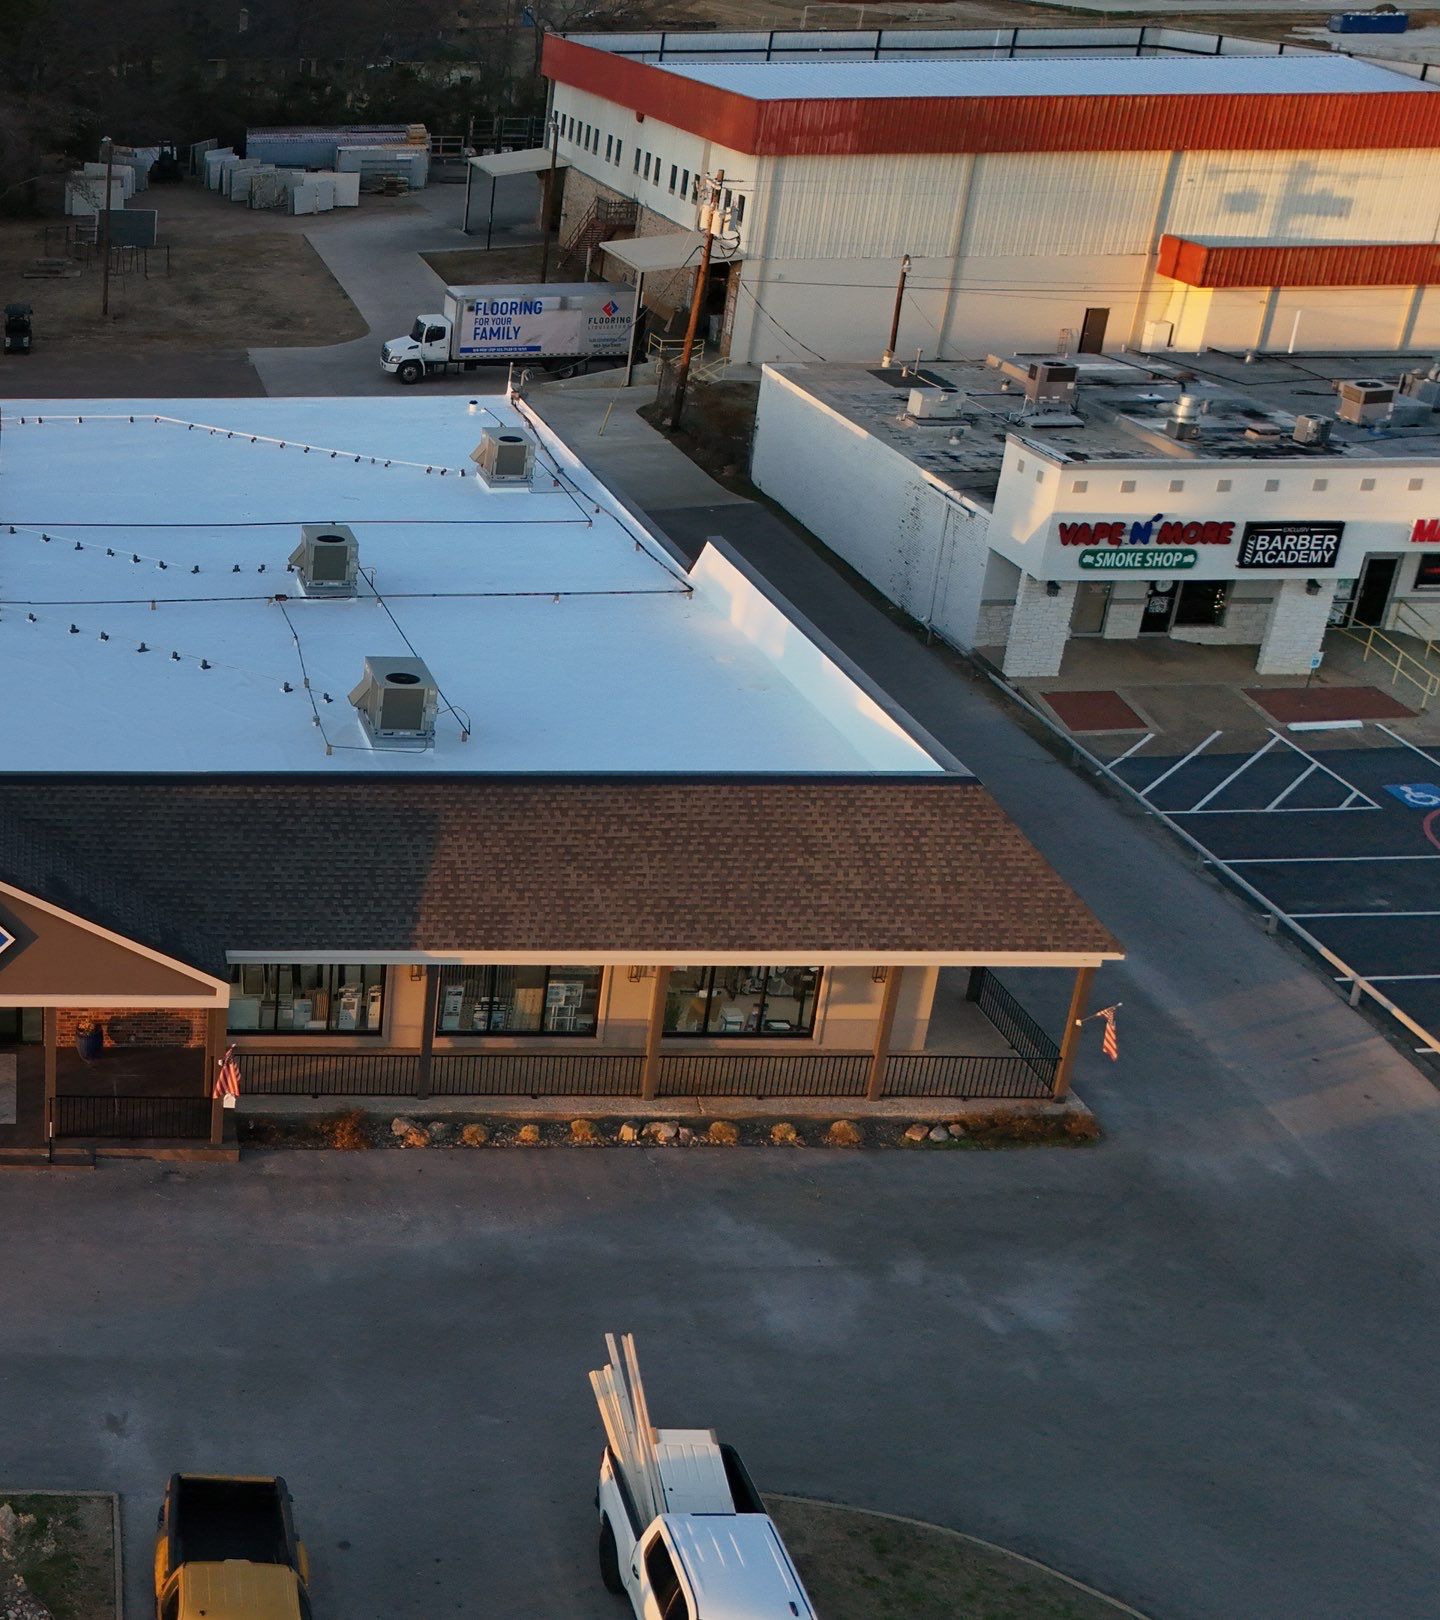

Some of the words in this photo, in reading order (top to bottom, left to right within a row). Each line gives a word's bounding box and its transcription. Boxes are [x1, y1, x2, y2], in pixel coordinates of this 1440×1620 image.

[475, 301, 543, 316] FLOORING
[474, 317, 489, 326] FOR
[492, 317, 512, 326] YOUR
[588, 316, 632, 325] FLOORING
[473, 326, 521, 341] FAMILY
[1059, 521, 1126, 546] VAPE
[1156, 521, 1235, 545] MORE
[1256, 535, 1338, 550] BARBER
[1094, 552, 1142, 567] SMOKE
[1144, 551, 1183, 567] SHOP
[1252, 550, 1334, 564] ACADEMY
